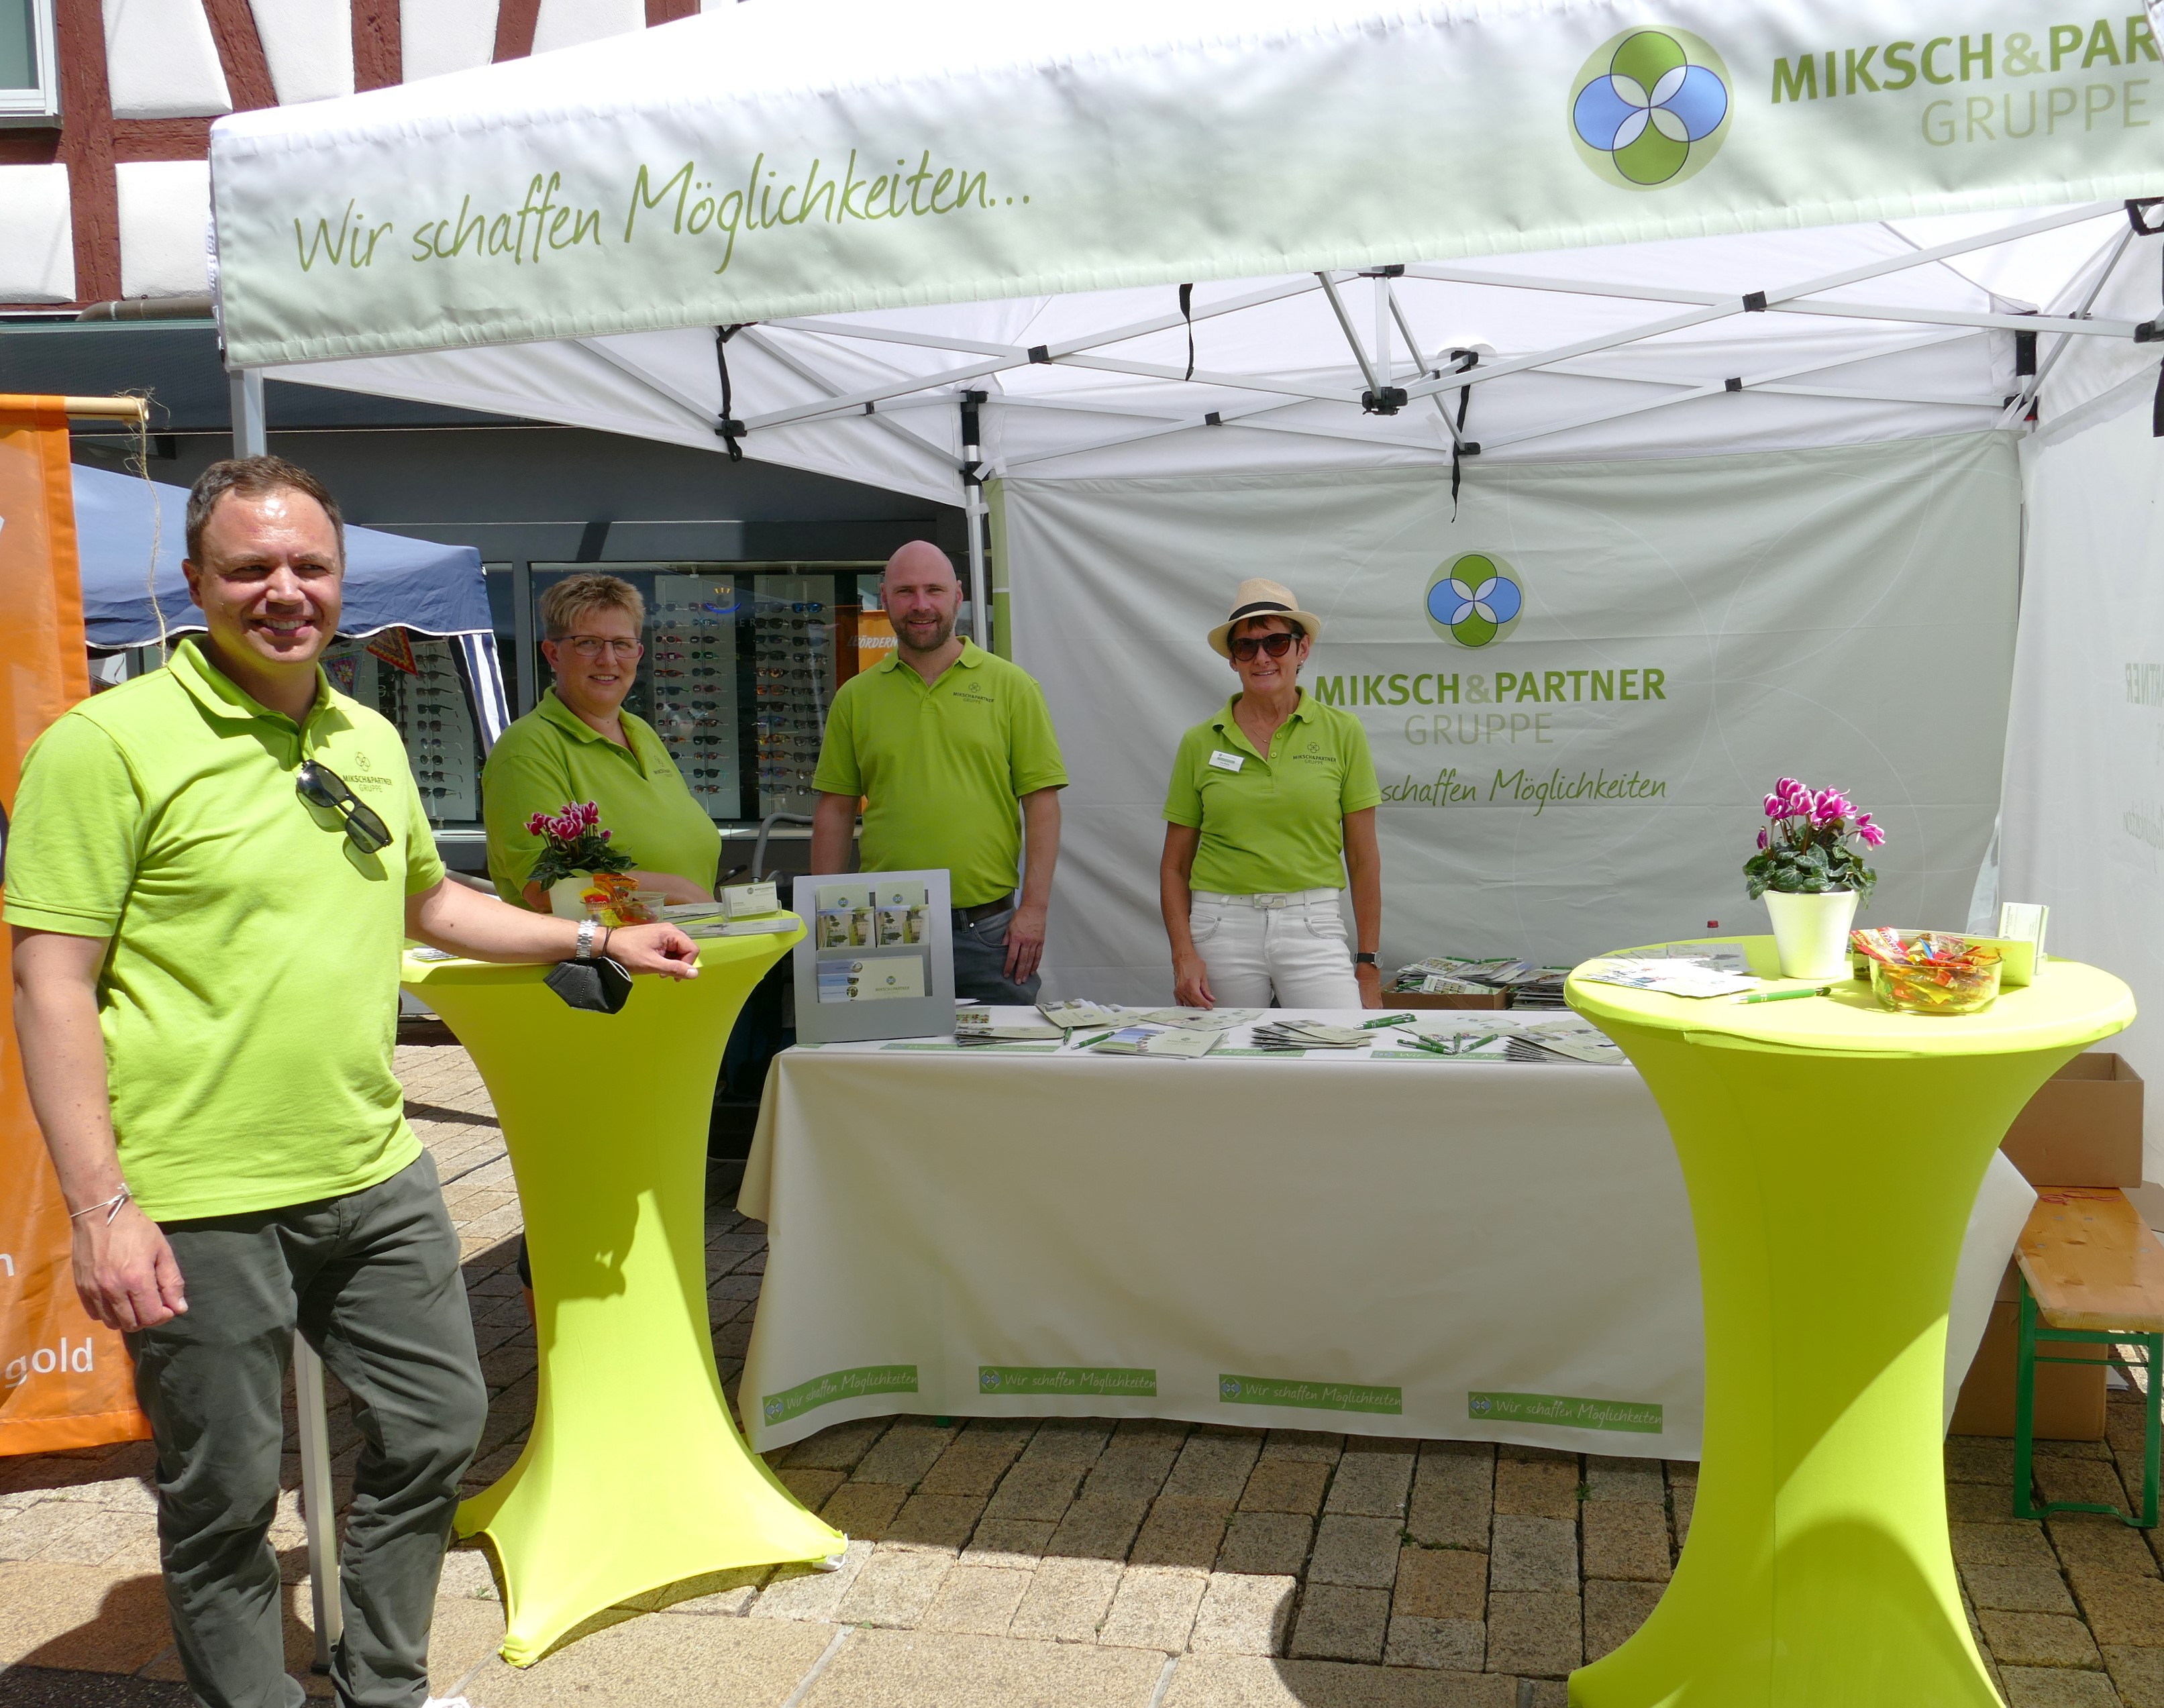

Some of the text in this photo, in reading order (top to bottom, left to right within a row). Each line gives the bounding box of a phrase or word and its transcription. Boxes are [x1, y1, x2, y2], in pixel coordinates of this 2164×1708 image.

[1921, 78, 2151, 146] GRUPPE
[294, 148, 1029, 274] Wir schaffen Möglichkeiten...
[953, 692, 995, 703] MIKSCH&PARTNER
[1315, 668, 1666, 706] MIKSCH&PARTNER
[1404, 712, 1554, 745] GRUPPE
[1292, 755, 1337, 763] MIKSCH&PARTNER
[342, 775, 393, 786] MIKSCH&PARTNER
[359, 784, 383, 792] GRUPPE
[1382, 768, 1666, 816] schaffen Möglichkeiten
[787, 1371, 917, 1409] Wir schaffen Möglichkeiten
[1005, 1371, 1155, 1393] Wir schaffen Möglichkeiten
[1245, 1383, 1401, 1408] Wir schaffen Möglichkeiten
[1496, 1400, 1662, 1428] Wir schaffen Möglichkeiten
